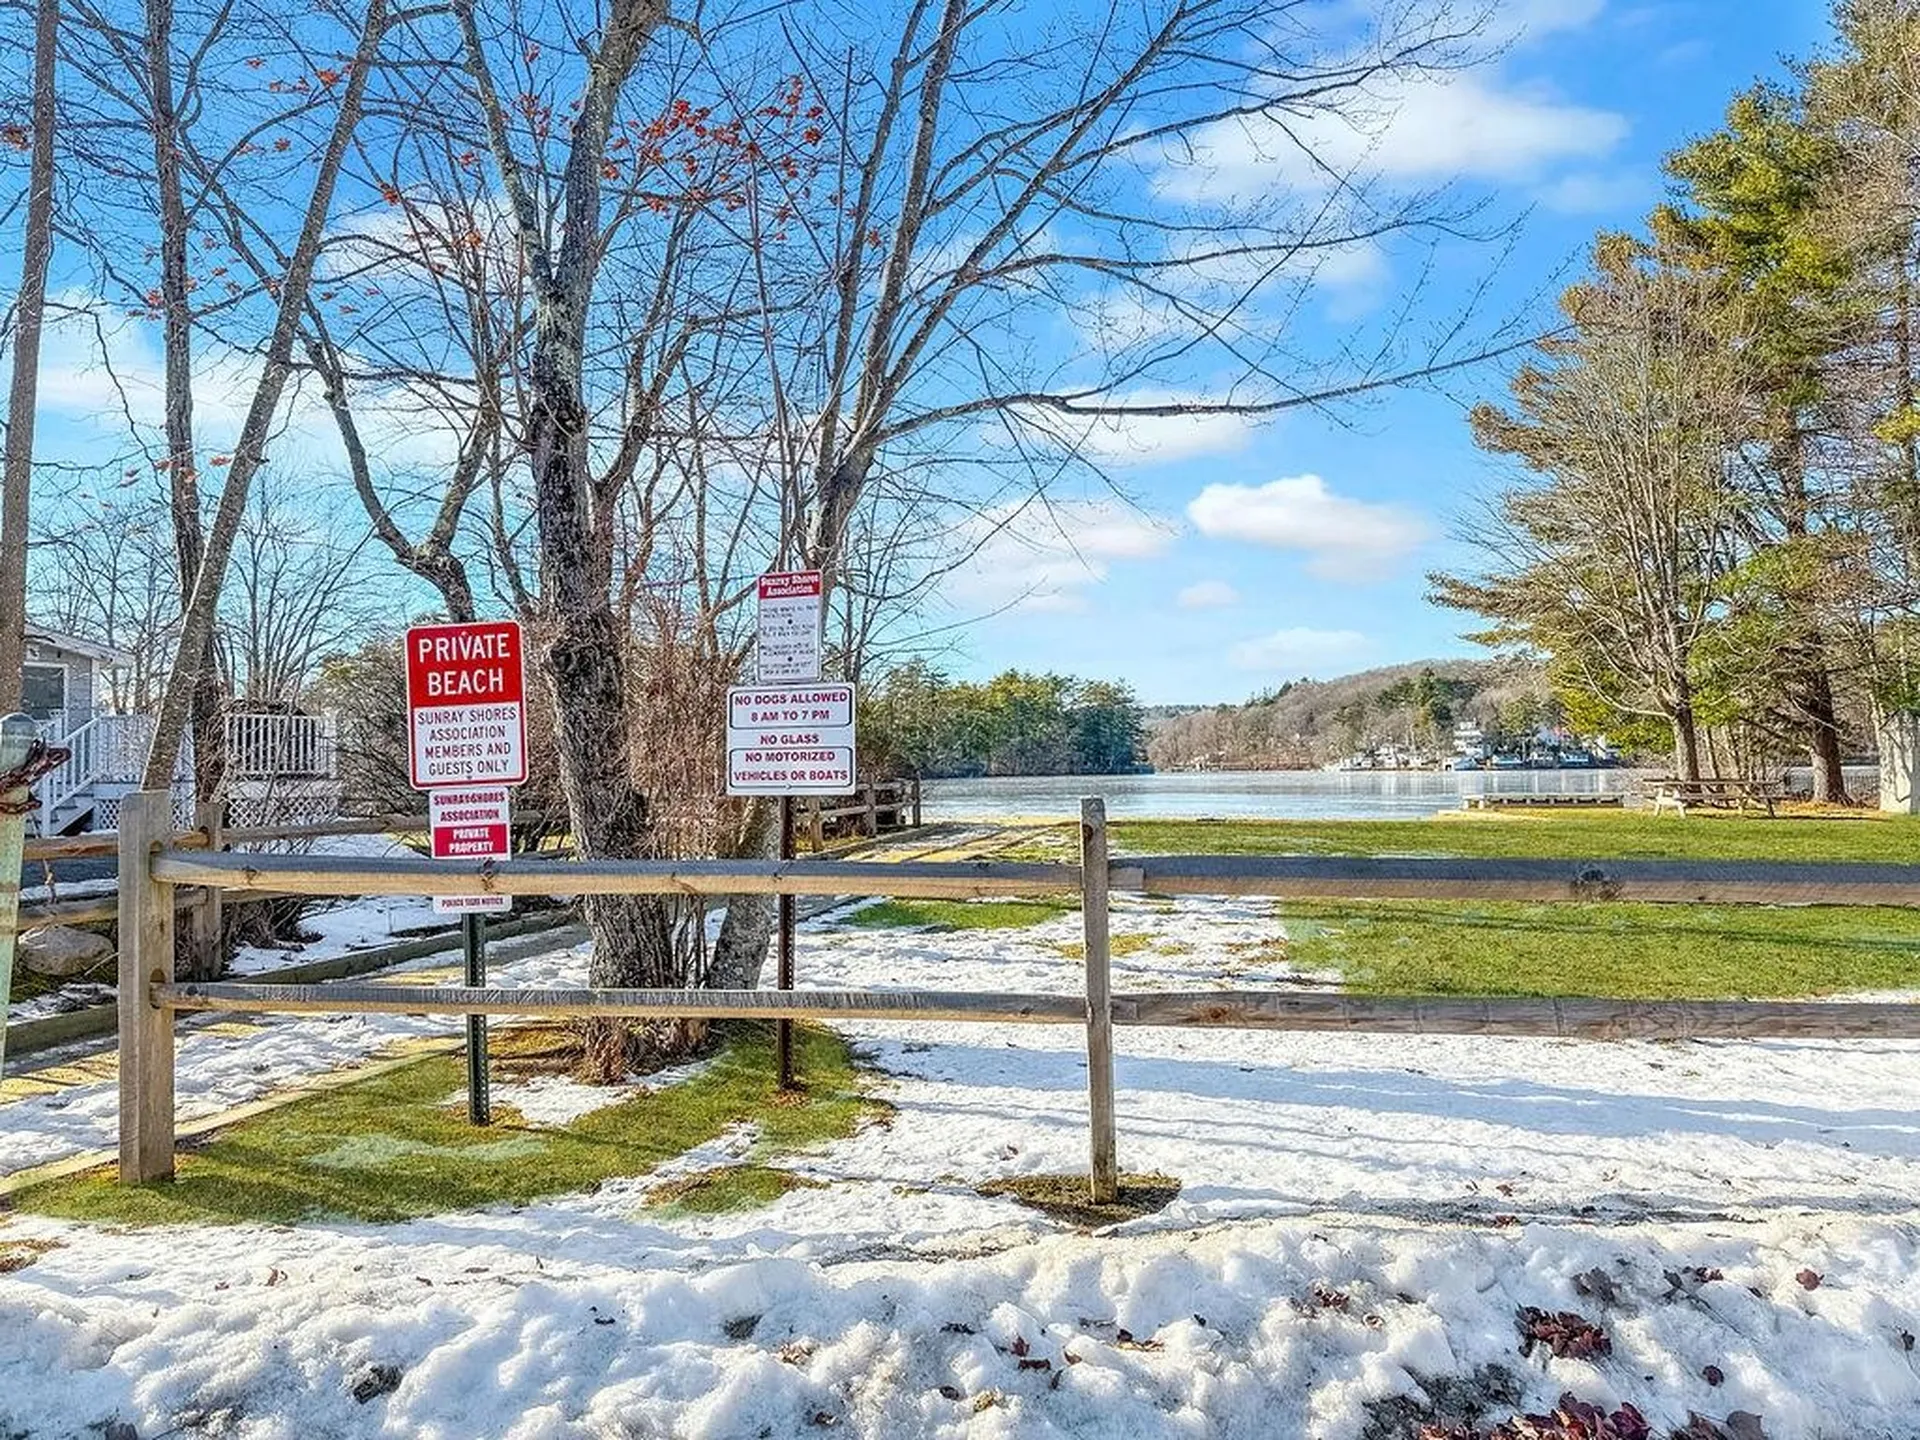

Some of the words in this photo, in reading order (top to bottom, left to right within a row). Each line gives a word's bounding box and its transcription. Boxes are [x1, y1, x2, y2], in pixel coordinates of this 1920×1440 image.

[419, 633, 510, 663] PRIVATE
[428, 668, 503, 696] BEACH
[735, 694, 751, 705] NO
[755, 694, 787, 704] DOGS
[791, 692, 847, 703] ALLOWED
[417, 709, 464, 725] SUNRAY
[469, 706, 517, 722] SHORES
[751, 712, 758, 721] 8
[761, 711, 778, 720] AM
[782, 710, 798, 720] TO
[802, 710, 808, 720] 7
[812, 710, 829, 719] PM
[429, 725, 506, 741] ASSOCIATION
[760, 735, 777, 744] NO
[781, 734, 819, 744] GLASS
[425, 743, 482, 759] MEMBERS
[486, 741, 511, 755] AND
[745, 752, 762, 761] NO
[765, 751, 835, 761] MOTORIZED
[429, 760, 473, 776] GUESTS
[477, 759, 509, 773] ONLY
[734, 771, 787, 780] VEHICLES
[791, 771, 805, 780] OR
[809, 770, 847, 780] BOATS
[440, 809, 499, 822] ASSOCIATION
[453, 827, 490, 840] PRIVATE
[449, 841, 493, 854] PROPERTY
